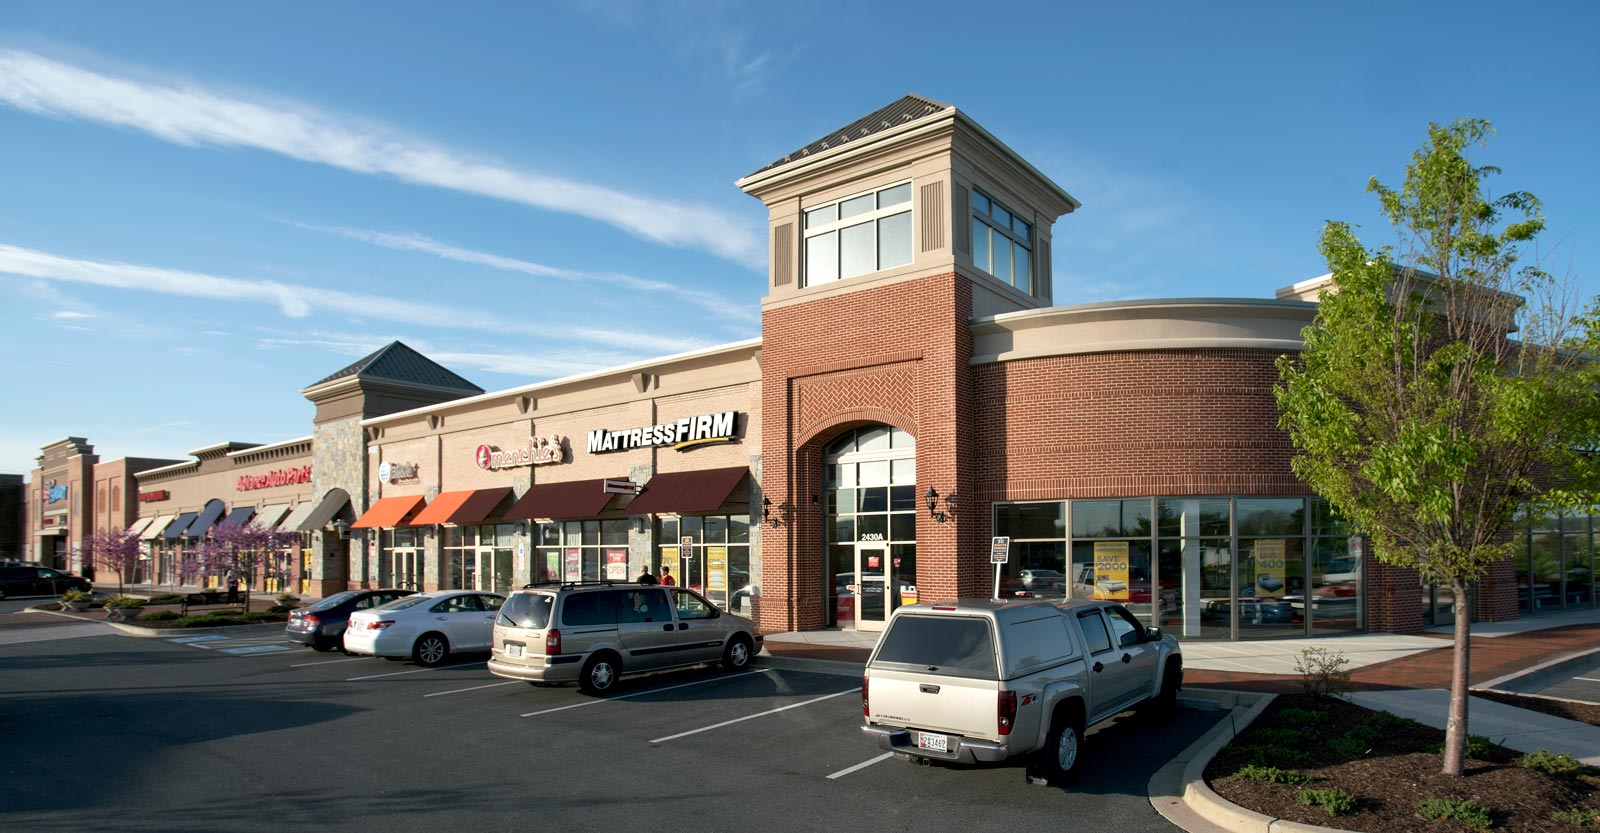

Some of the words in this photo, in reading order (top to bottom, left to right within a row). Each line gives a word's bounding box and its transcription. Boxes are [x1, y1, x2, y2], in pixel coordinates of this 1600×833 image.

[266, 470, 286, 487] Auto
[861, 533, 884, 541] 2430A
[608, 565, 625, 575] OPEN
